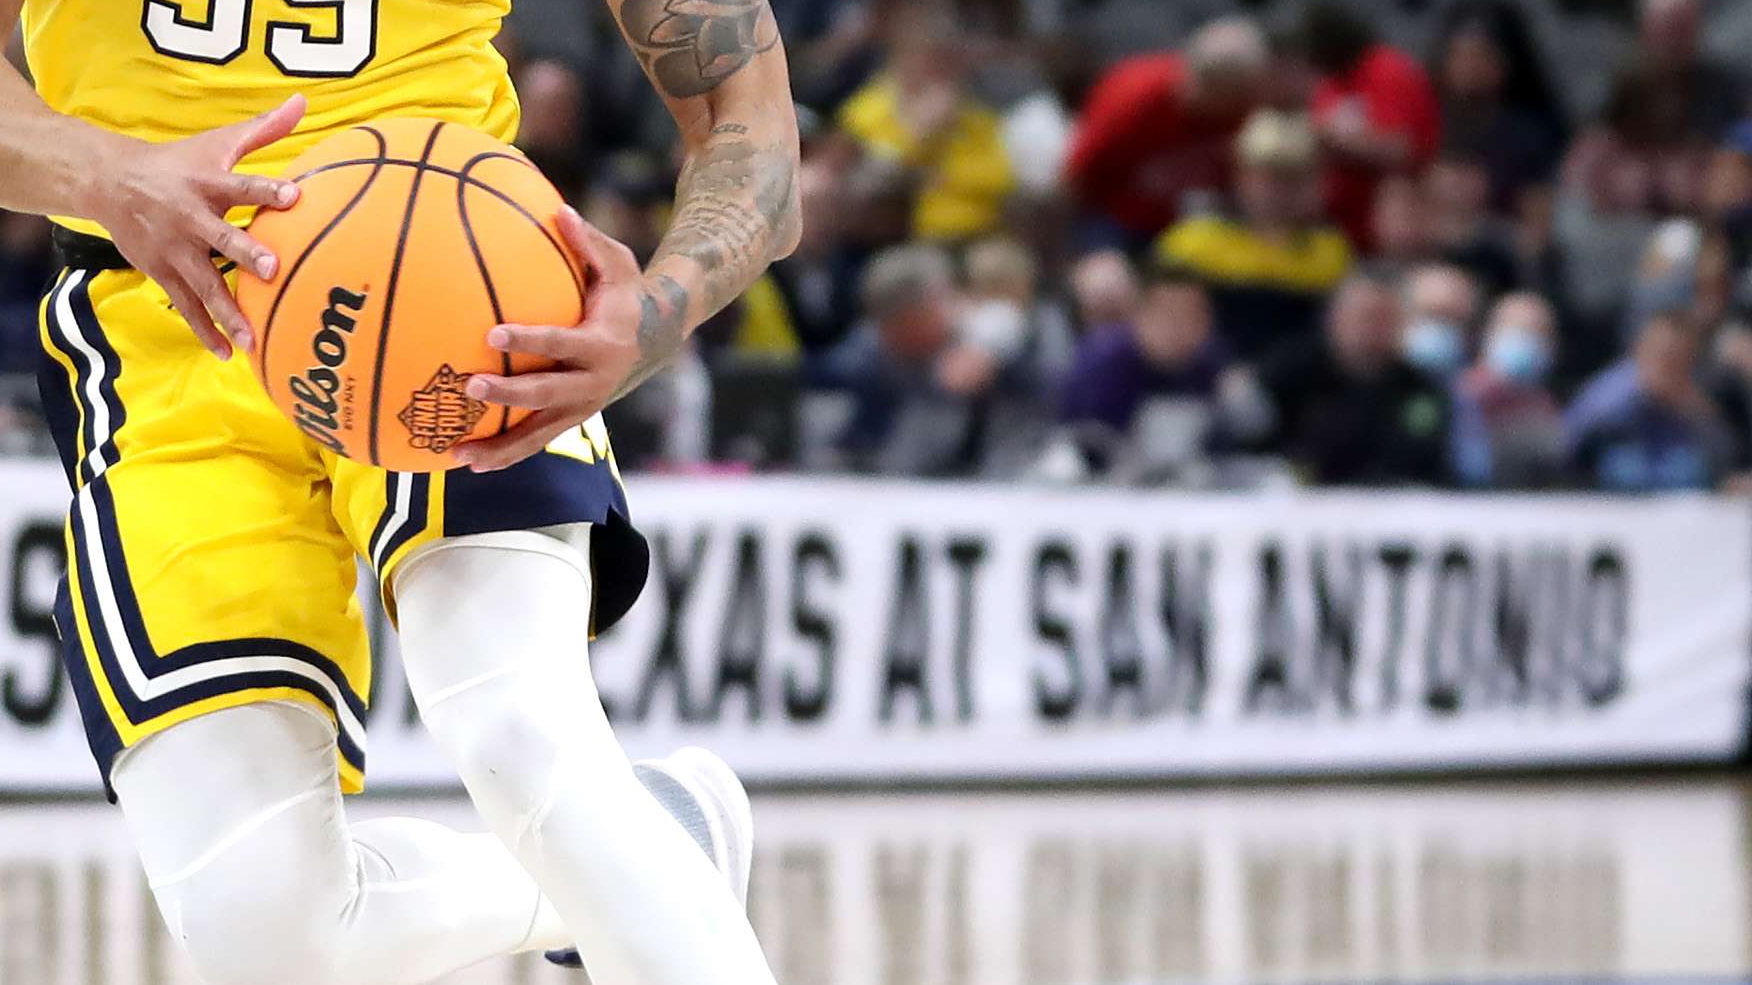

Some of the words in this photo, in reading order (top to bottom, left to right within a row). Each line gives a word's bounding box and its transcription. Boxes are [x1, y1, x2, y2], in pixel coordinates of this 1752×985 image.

[878, 528, 994, 728] AT
[1029, 536, 1216, 722] SAN
[1247, 536, 1632, 718] ANTONIO
